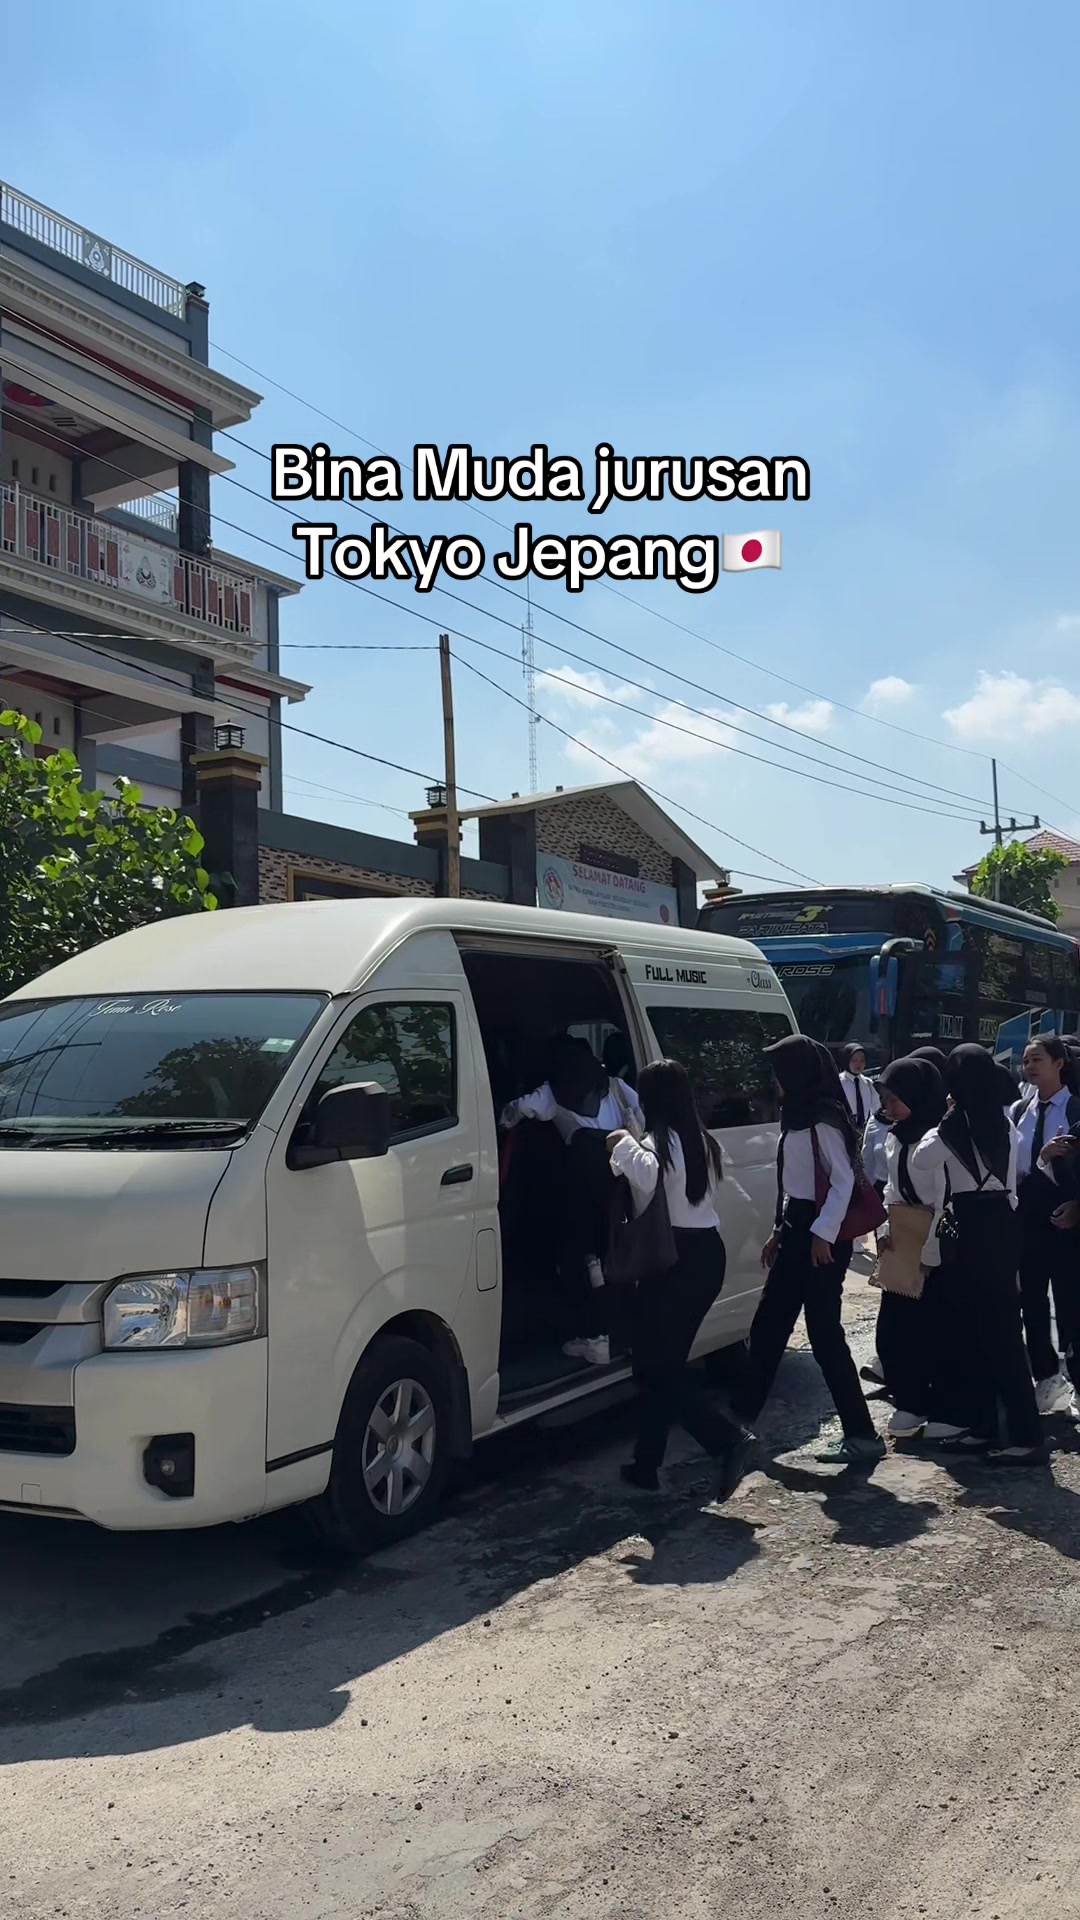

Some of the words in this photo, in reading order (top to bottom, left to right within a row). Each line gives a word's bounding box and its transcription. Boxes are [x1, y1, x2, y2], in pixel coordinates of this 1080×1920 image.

[572, 864, 610, 886] SELAMAT
[613, 875, 646, 894] DATANG
[645, 964, 673, 981] FULL
[676, 968, 707, 984] MUSIC
